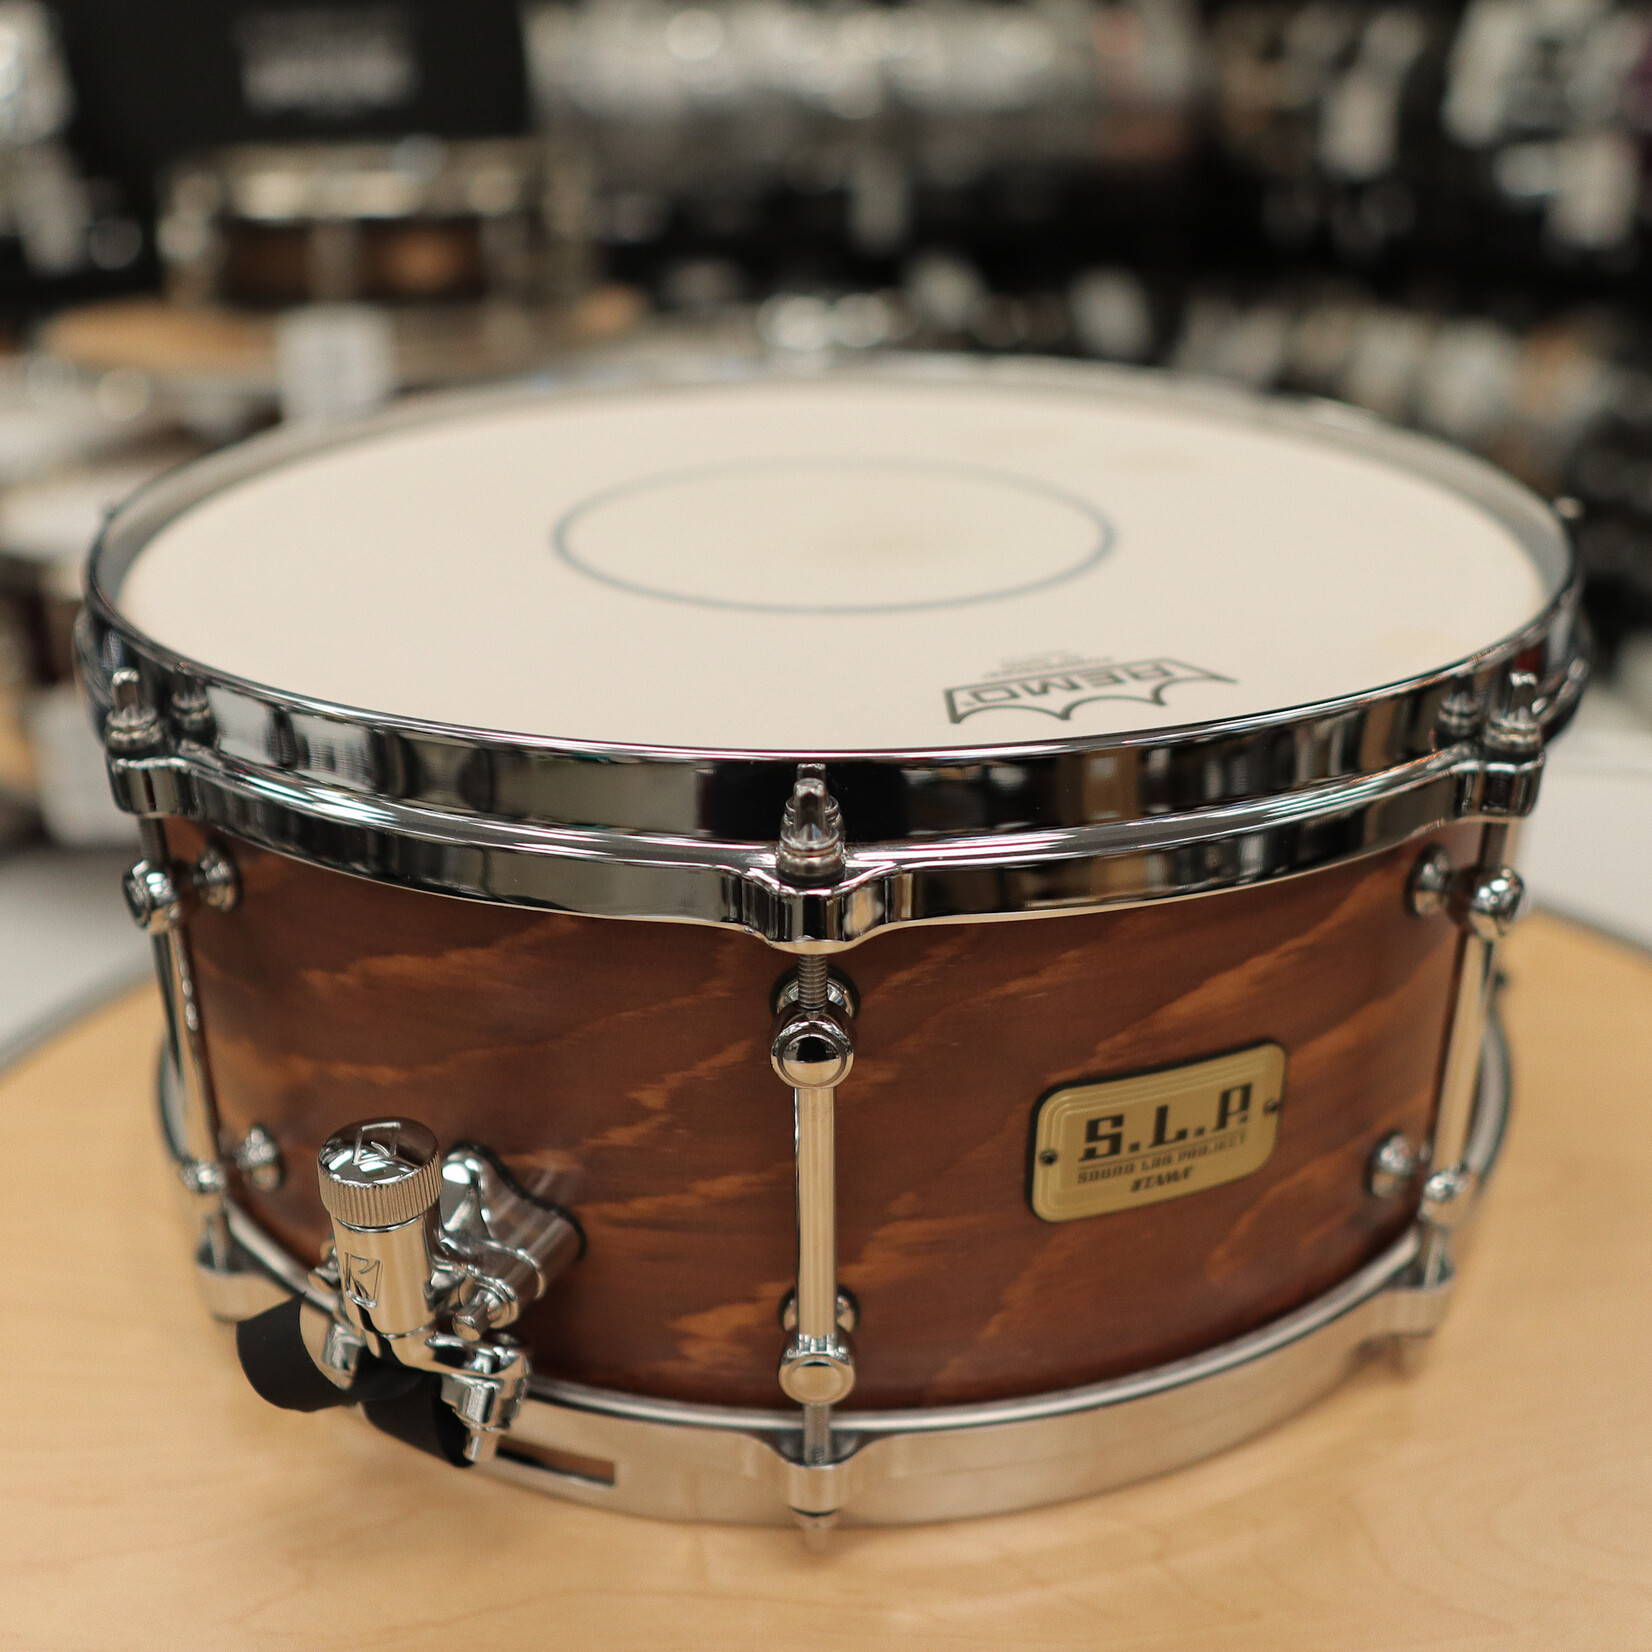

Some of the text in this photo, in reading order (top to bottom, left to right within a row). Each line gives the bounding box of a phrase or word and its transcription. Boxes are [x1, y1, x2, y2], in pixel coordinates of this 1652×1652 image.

[968, 664, 1174, 703] REMO
[1077, 1163, 1135, 1184] SOUND
[1141, 1152, 1172, 1171] LAB
